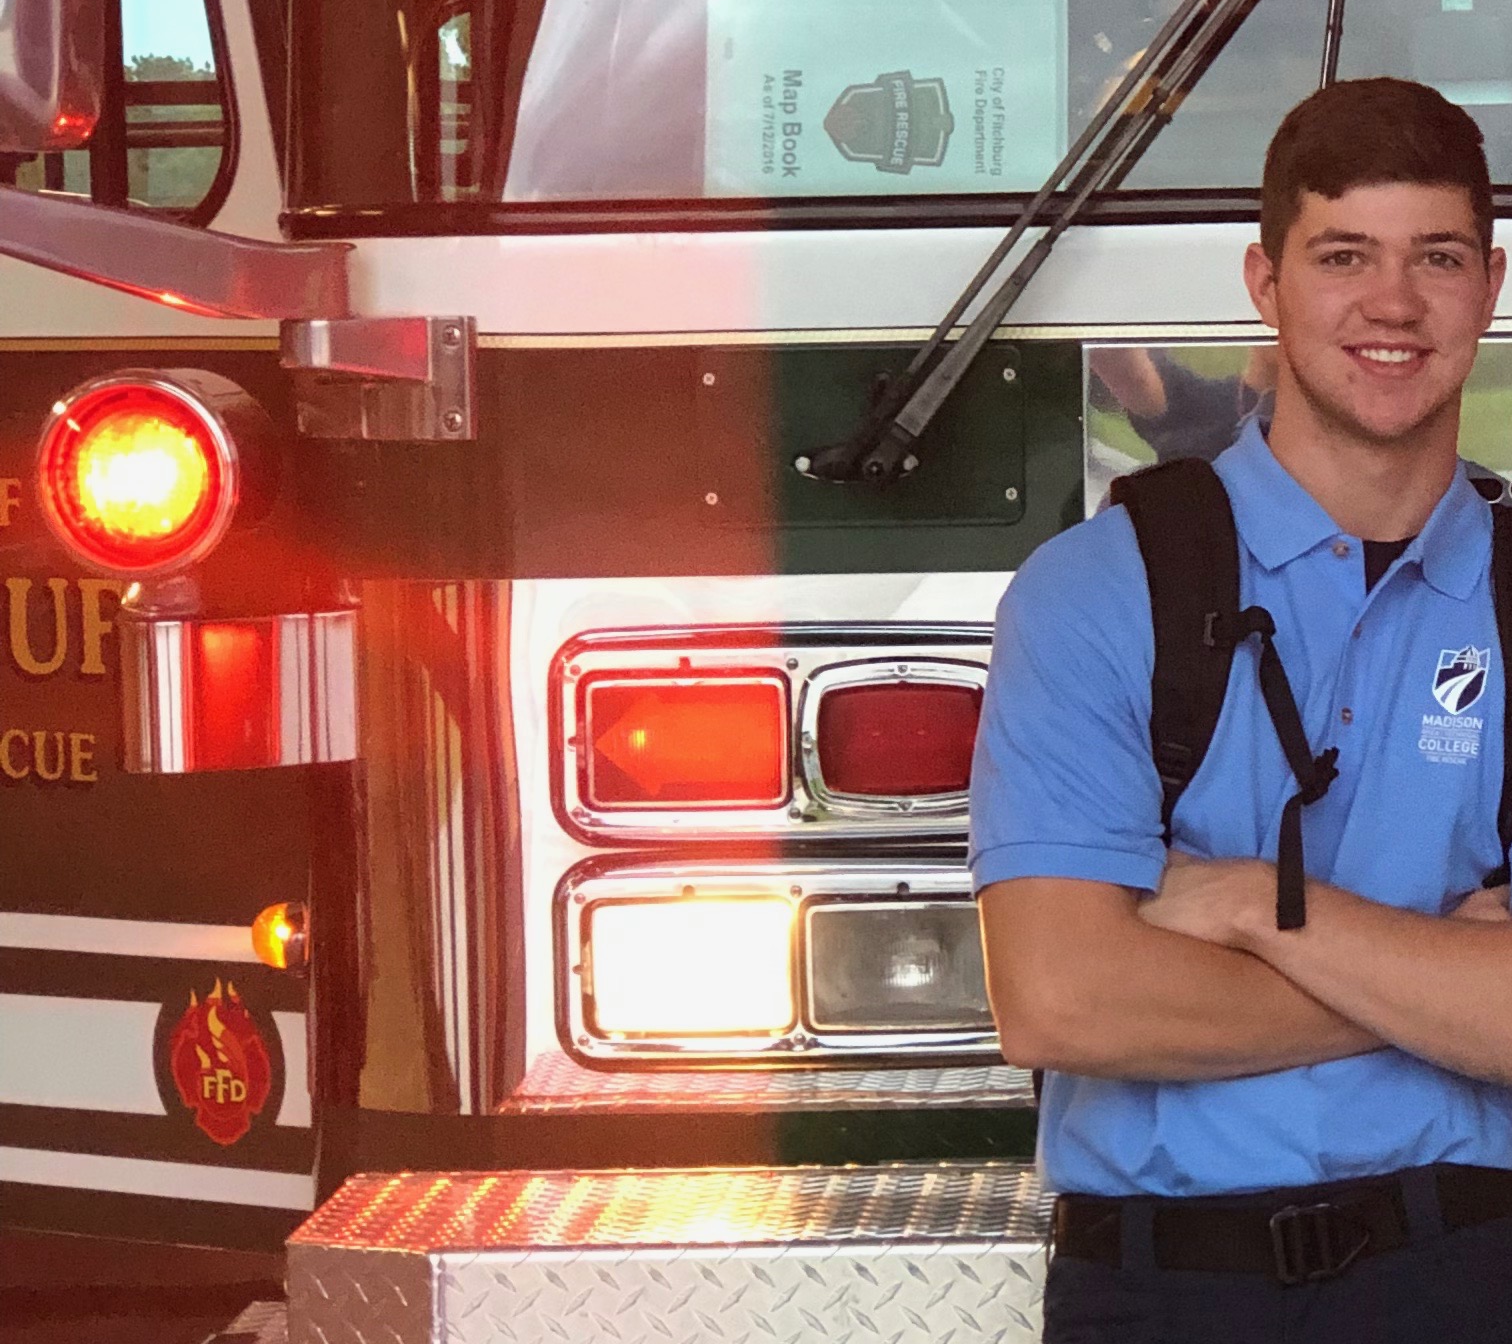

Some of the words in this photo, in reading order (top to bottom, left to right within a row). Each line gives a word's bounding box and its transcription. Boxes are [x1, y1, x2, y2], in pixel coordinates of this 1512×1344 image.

[781, 69, 803, 115] Map
[891, 79, 909, 109] FIRE
[974, 69, 988, 95] Fire
[990, 67, 1005, 94] City
[762, 96, 775, 110] of
[992, 97, 1005, 110] of
[782, 121, 802, 178] Book
[890, 112, 909, 166] RESCUE
[972, 99, 987, 174] Department
[989, 113, 1004, 177] Fitchburg
[1422, 715, 1483, 729] MADISON
[1418, 739, 1479, 754] COLLEGE
[203, 1069, 247, 1104] FFD
